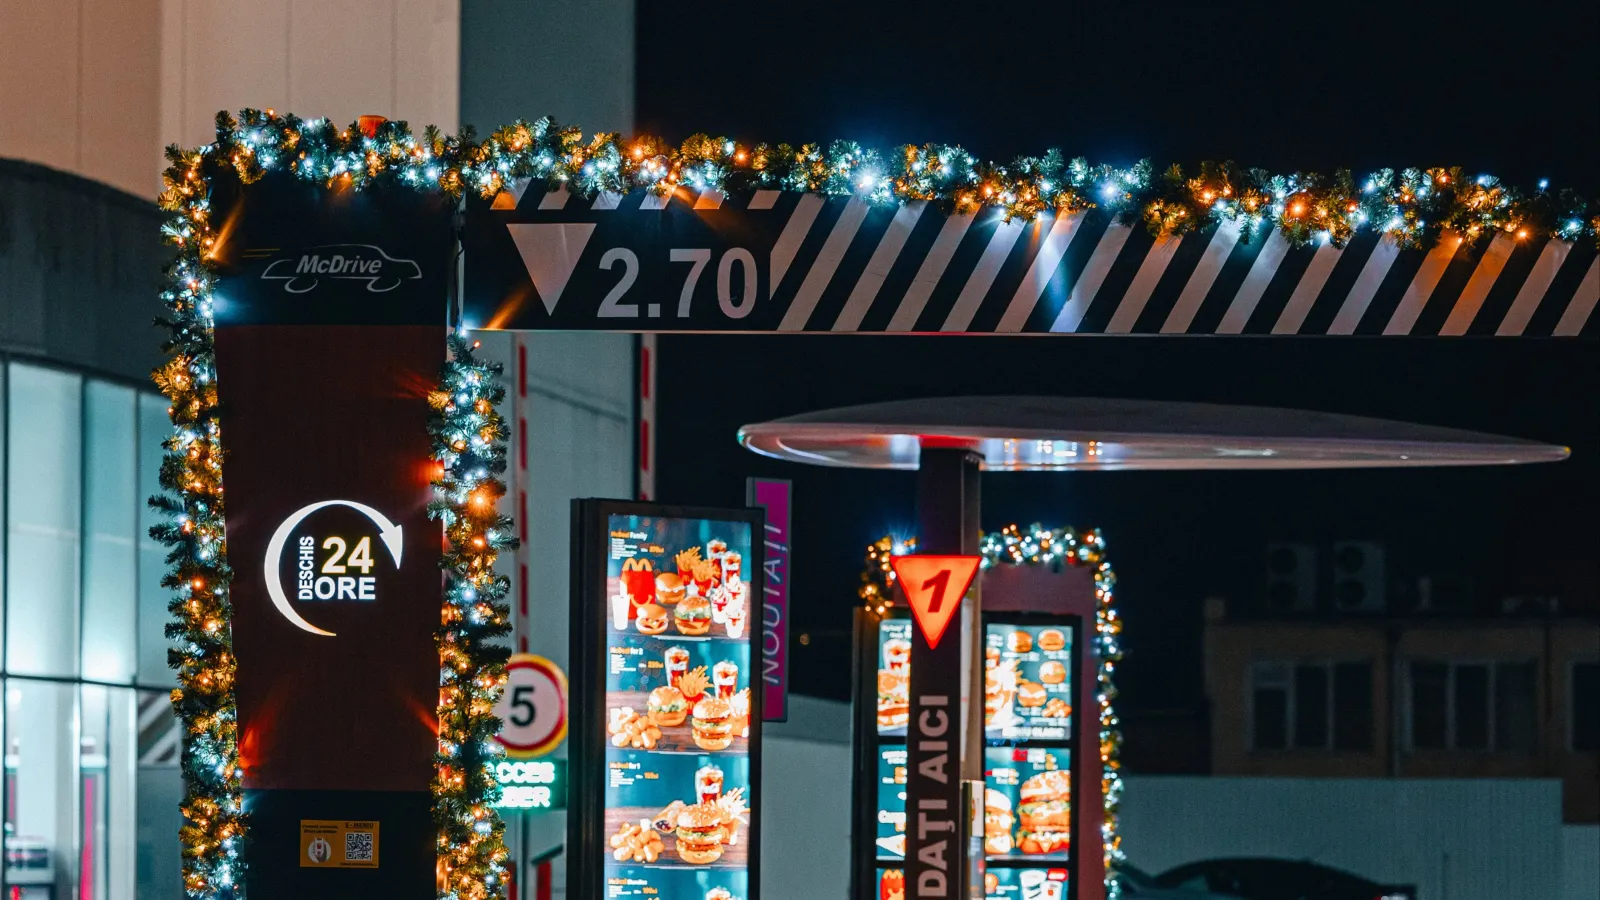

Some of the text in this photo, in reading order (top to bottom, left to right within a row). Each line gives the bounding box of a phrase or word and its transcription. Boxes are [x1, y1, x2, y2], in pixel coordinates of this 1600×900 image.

[296, 255, 382, 274] McDrive
[597, 247, 757, 319] 2.70
[299, 536, 315, 600] DESCHIS
[322, 536, 374, 574] 24
[315, 576, 376, 600] ORE
[921, 569, 951, 613] 1
[510, 685, 536, 727] 5
[919, 695, 949, 785] AICI
